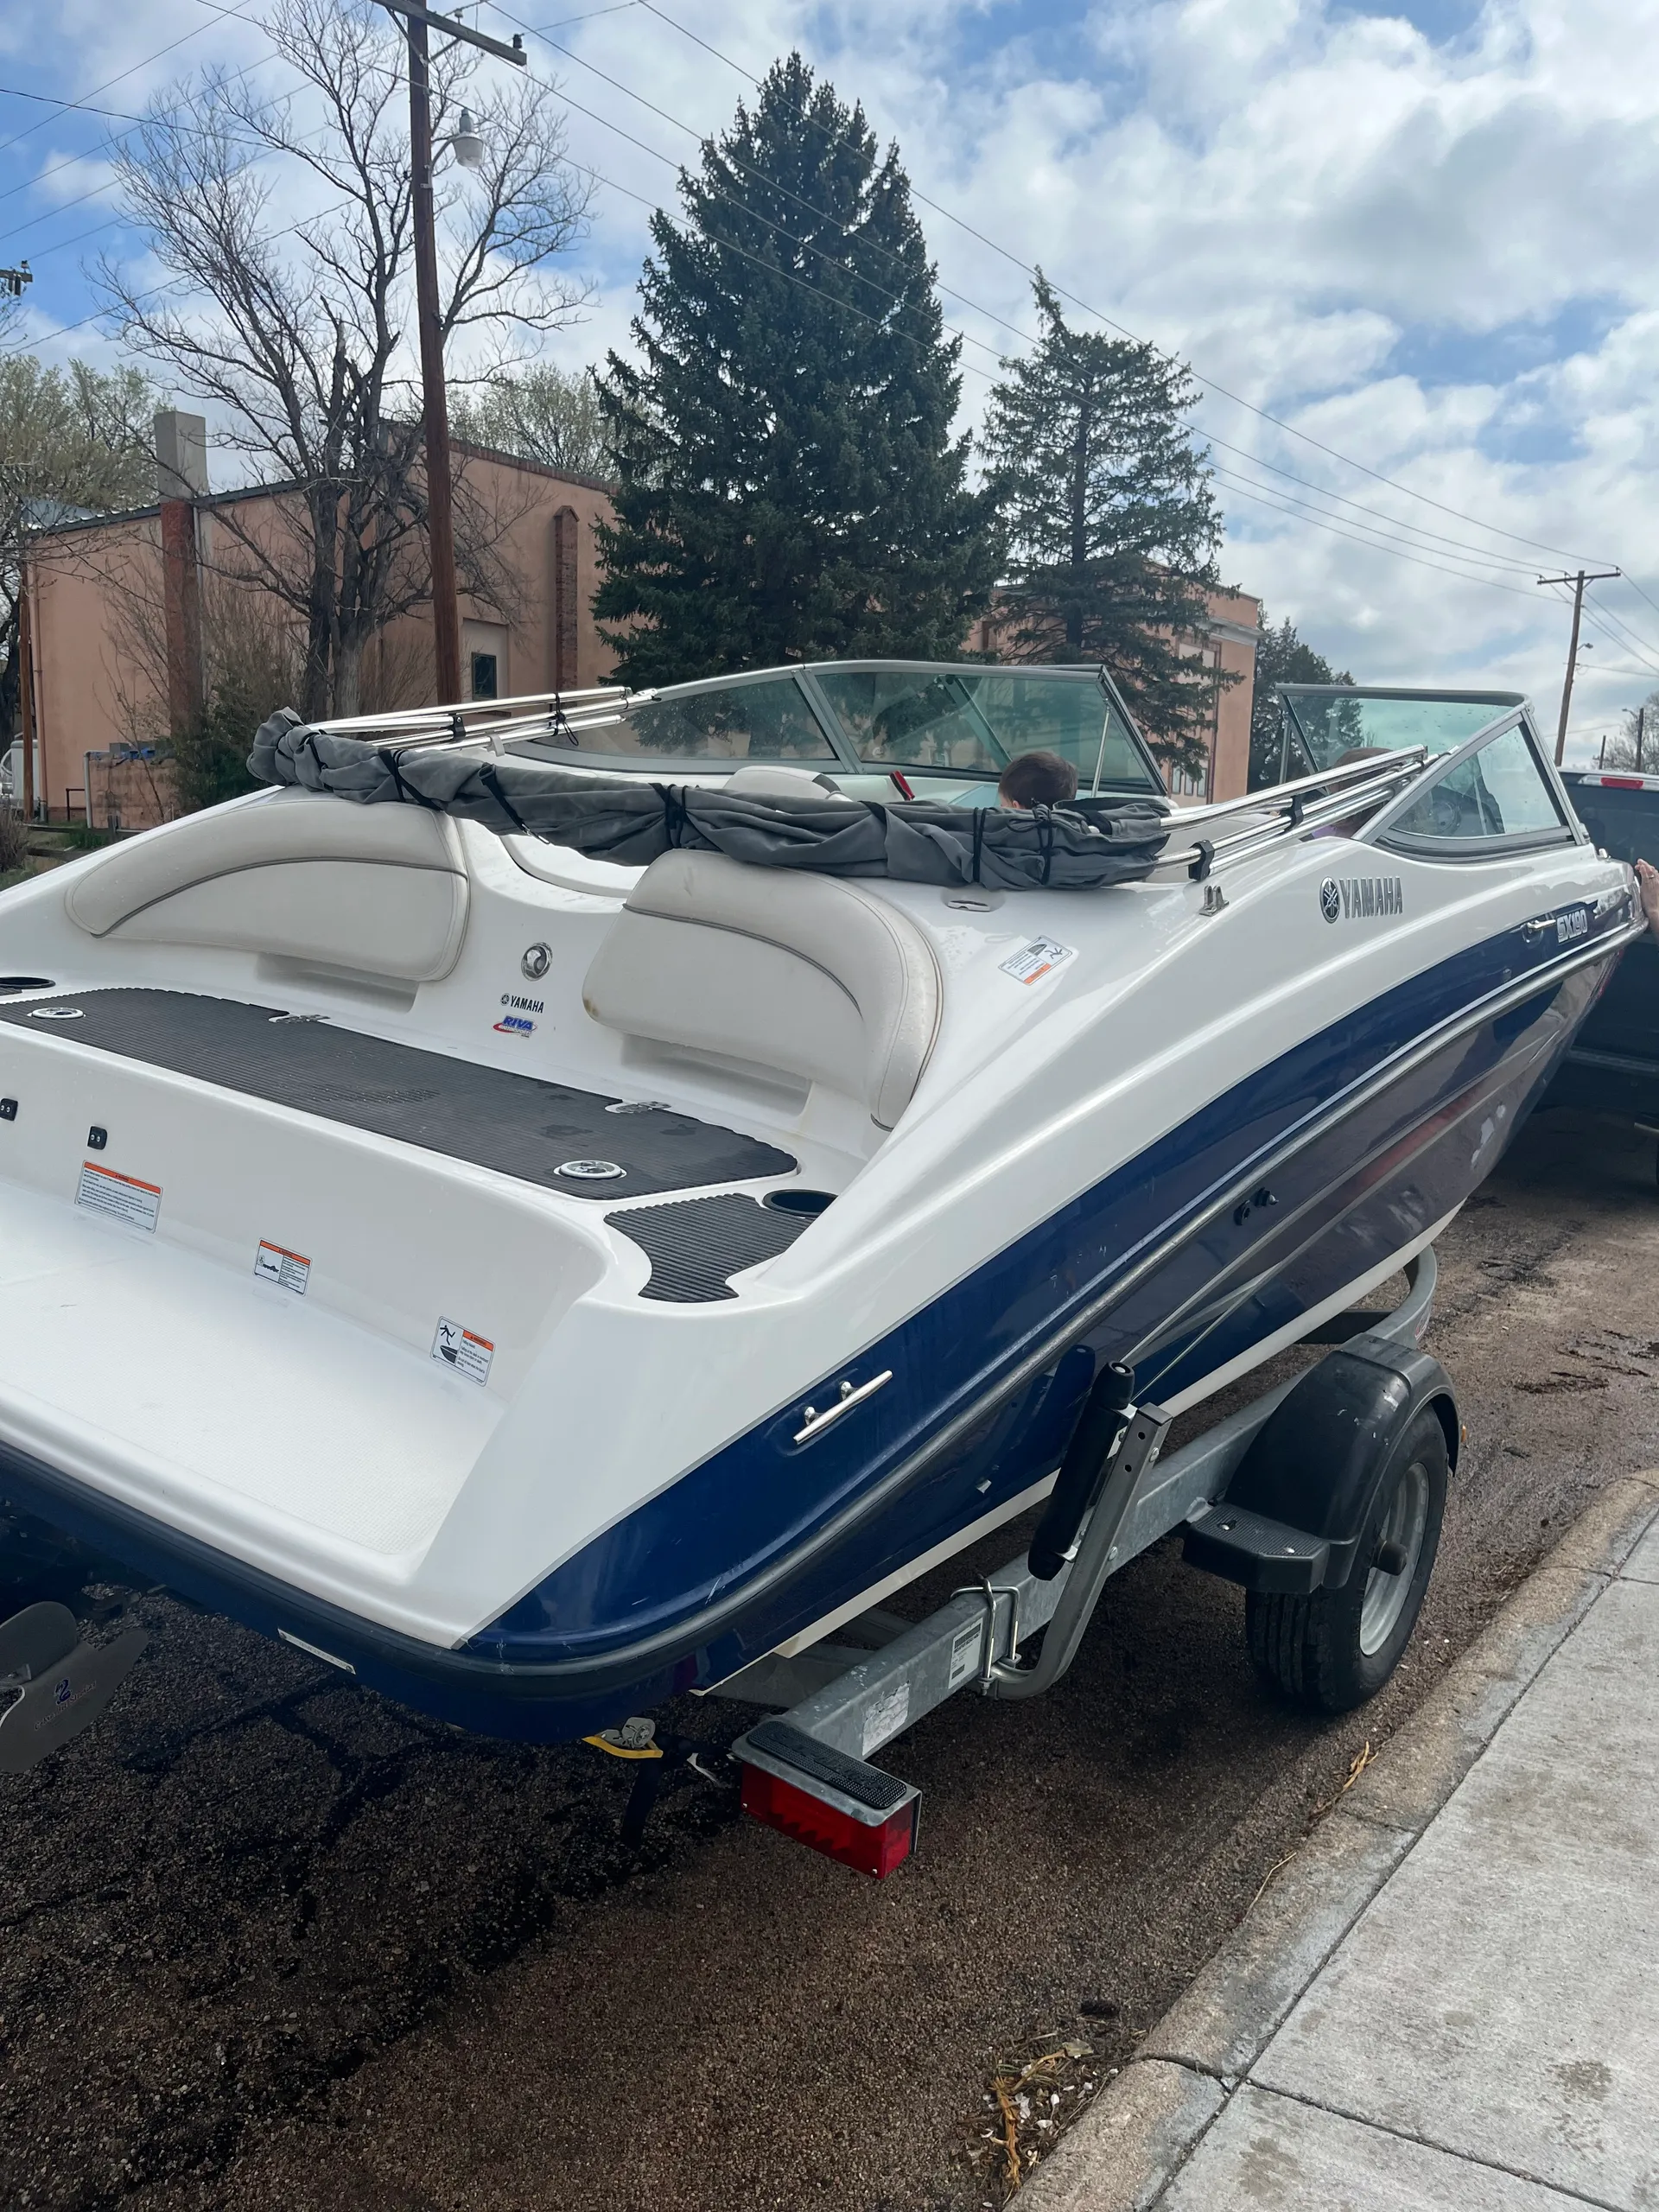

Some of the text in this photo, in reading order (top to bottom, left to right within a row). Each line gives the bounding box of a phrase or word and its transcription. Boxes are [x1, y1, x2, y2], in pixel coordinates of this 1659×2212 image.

[1339, 876, 1403, 918] YAMAHA
[511, 995, 544, 1014] YAMAHA
[503, 1016, 534, 1030] RIVA
